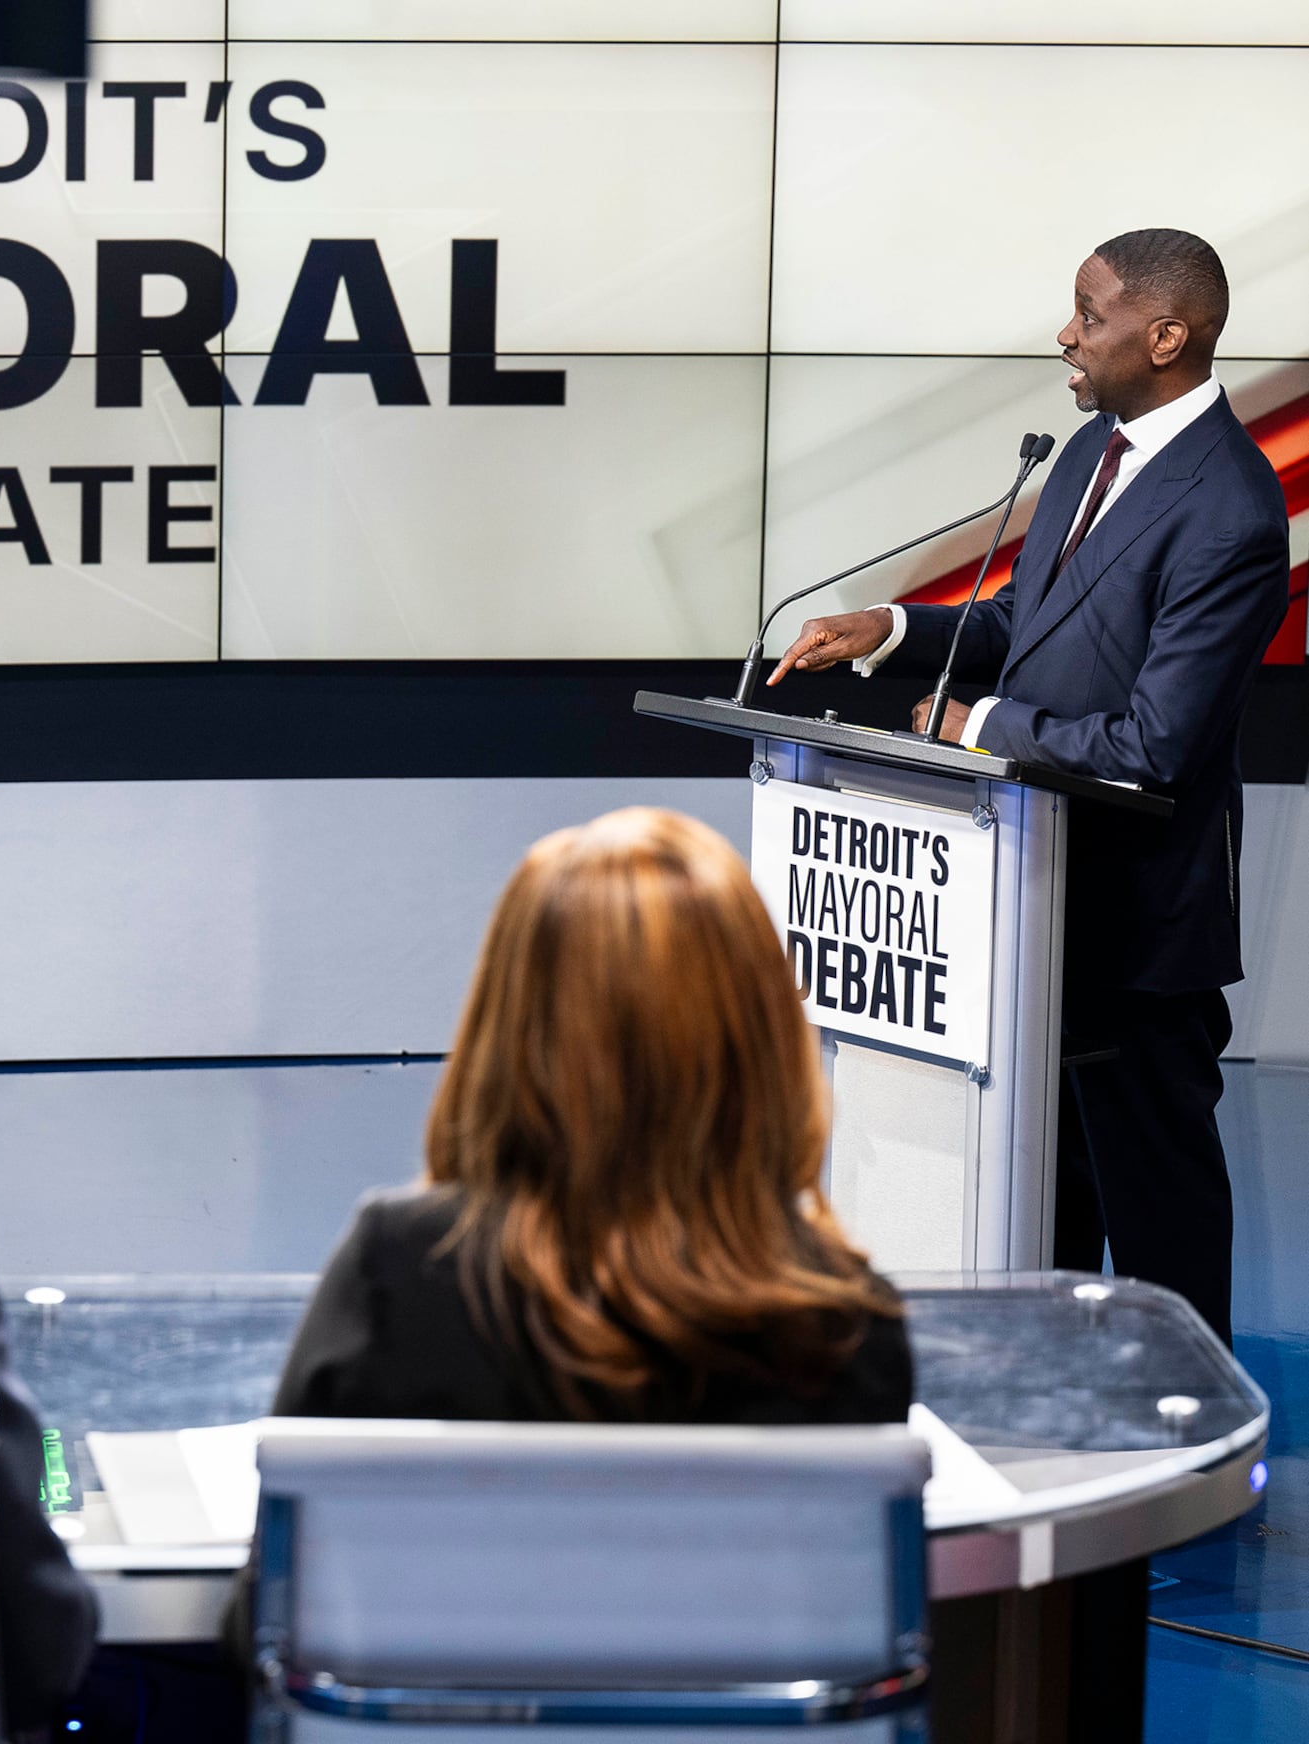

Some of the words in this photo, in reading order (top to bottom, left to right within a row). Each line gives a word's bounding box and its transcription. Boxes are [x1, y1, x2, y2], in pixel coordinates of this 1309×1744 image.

[792, 807, 949, 887] DETROIT'S
[788, 863, 949, 960] MAYORAL
[787, 930, 947, 1036] DEBATE
